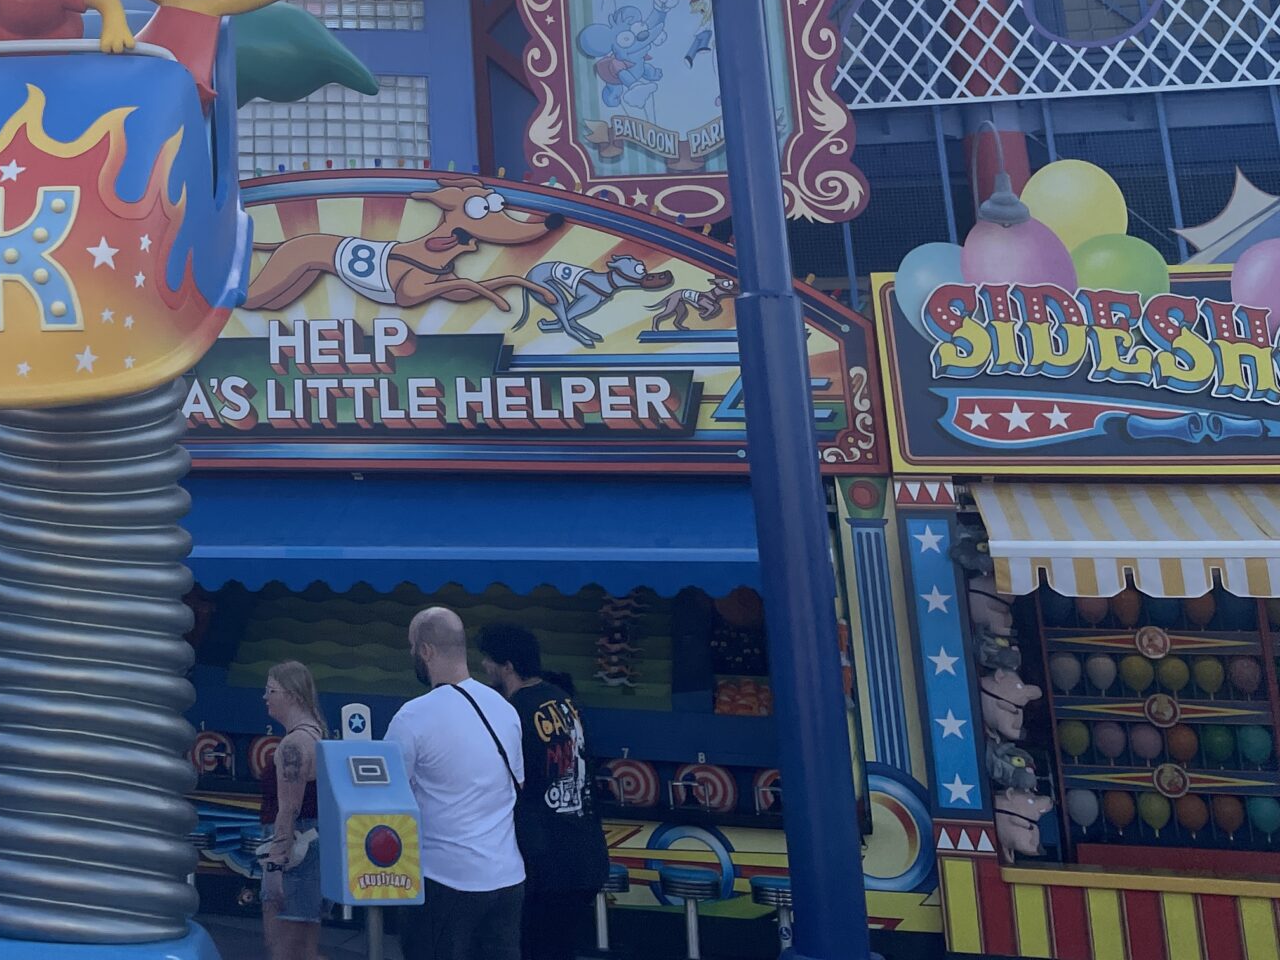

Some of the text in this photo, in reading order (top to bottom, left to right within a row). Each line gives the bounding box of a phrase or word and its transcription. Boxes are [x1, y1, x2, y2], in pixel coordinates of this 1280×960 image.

[613, 118, 677, 156] BALLOON
[347, 243, 377, 277] 8
[560, 265, 573, 281] 9
[268, 318, 411, 368] HELP
[921, 281, 1280, 406] SIDESH
[266, 377, 440, 422] LITTLE
[456, 376, 673, 422] HELPER
[266, 724, 273, 735] 2
[621, 747, 630, 759] 7
[697, 751, 706, 763] 8
[358, 871, 412, 890] KRUSTYLAND
